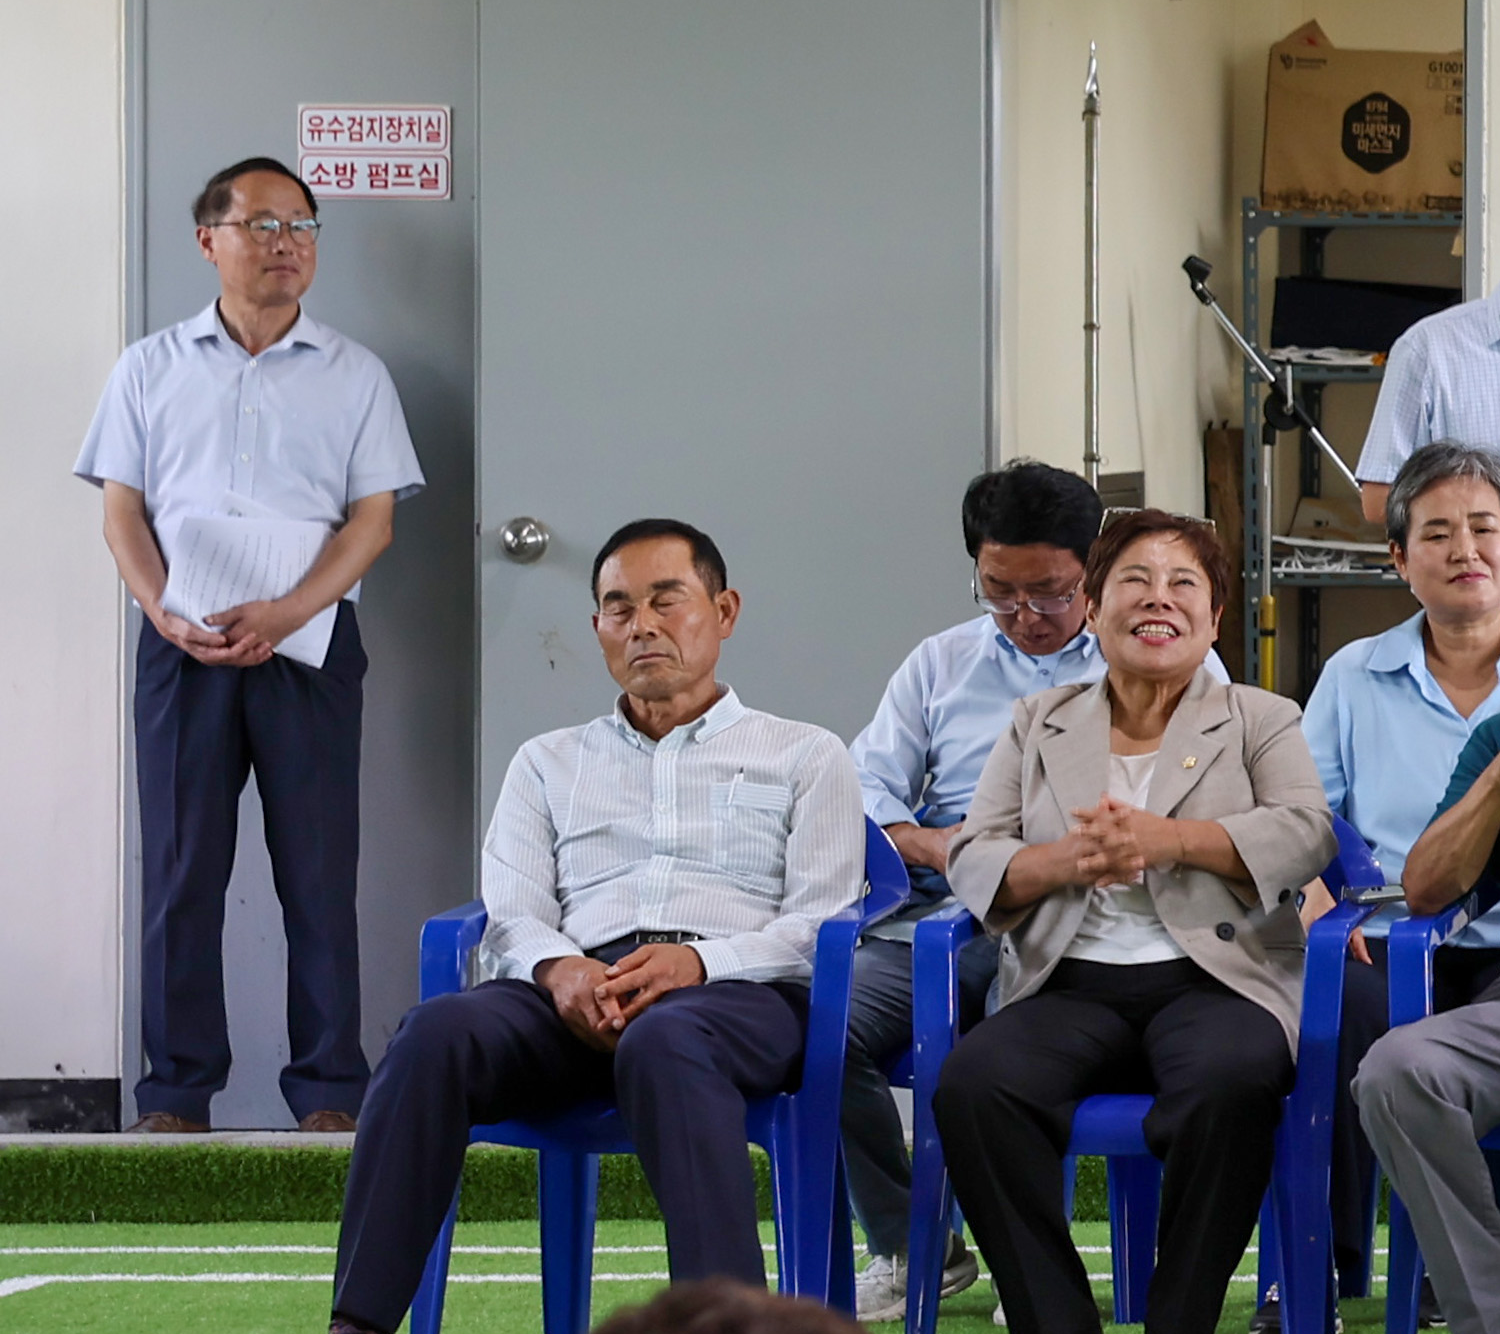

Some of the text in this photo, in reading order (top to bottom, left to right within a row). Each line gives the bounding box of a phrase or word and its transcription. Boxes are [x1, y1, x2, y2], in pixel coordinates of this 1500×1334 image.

[306, 114, 442, 144] 유수검지장치실
[1351, 121, 1401, 141] 미세먼지
[1357, 137, 1393, 154] 마스크
[308, 161, 441, 191] 소방 펌프실
